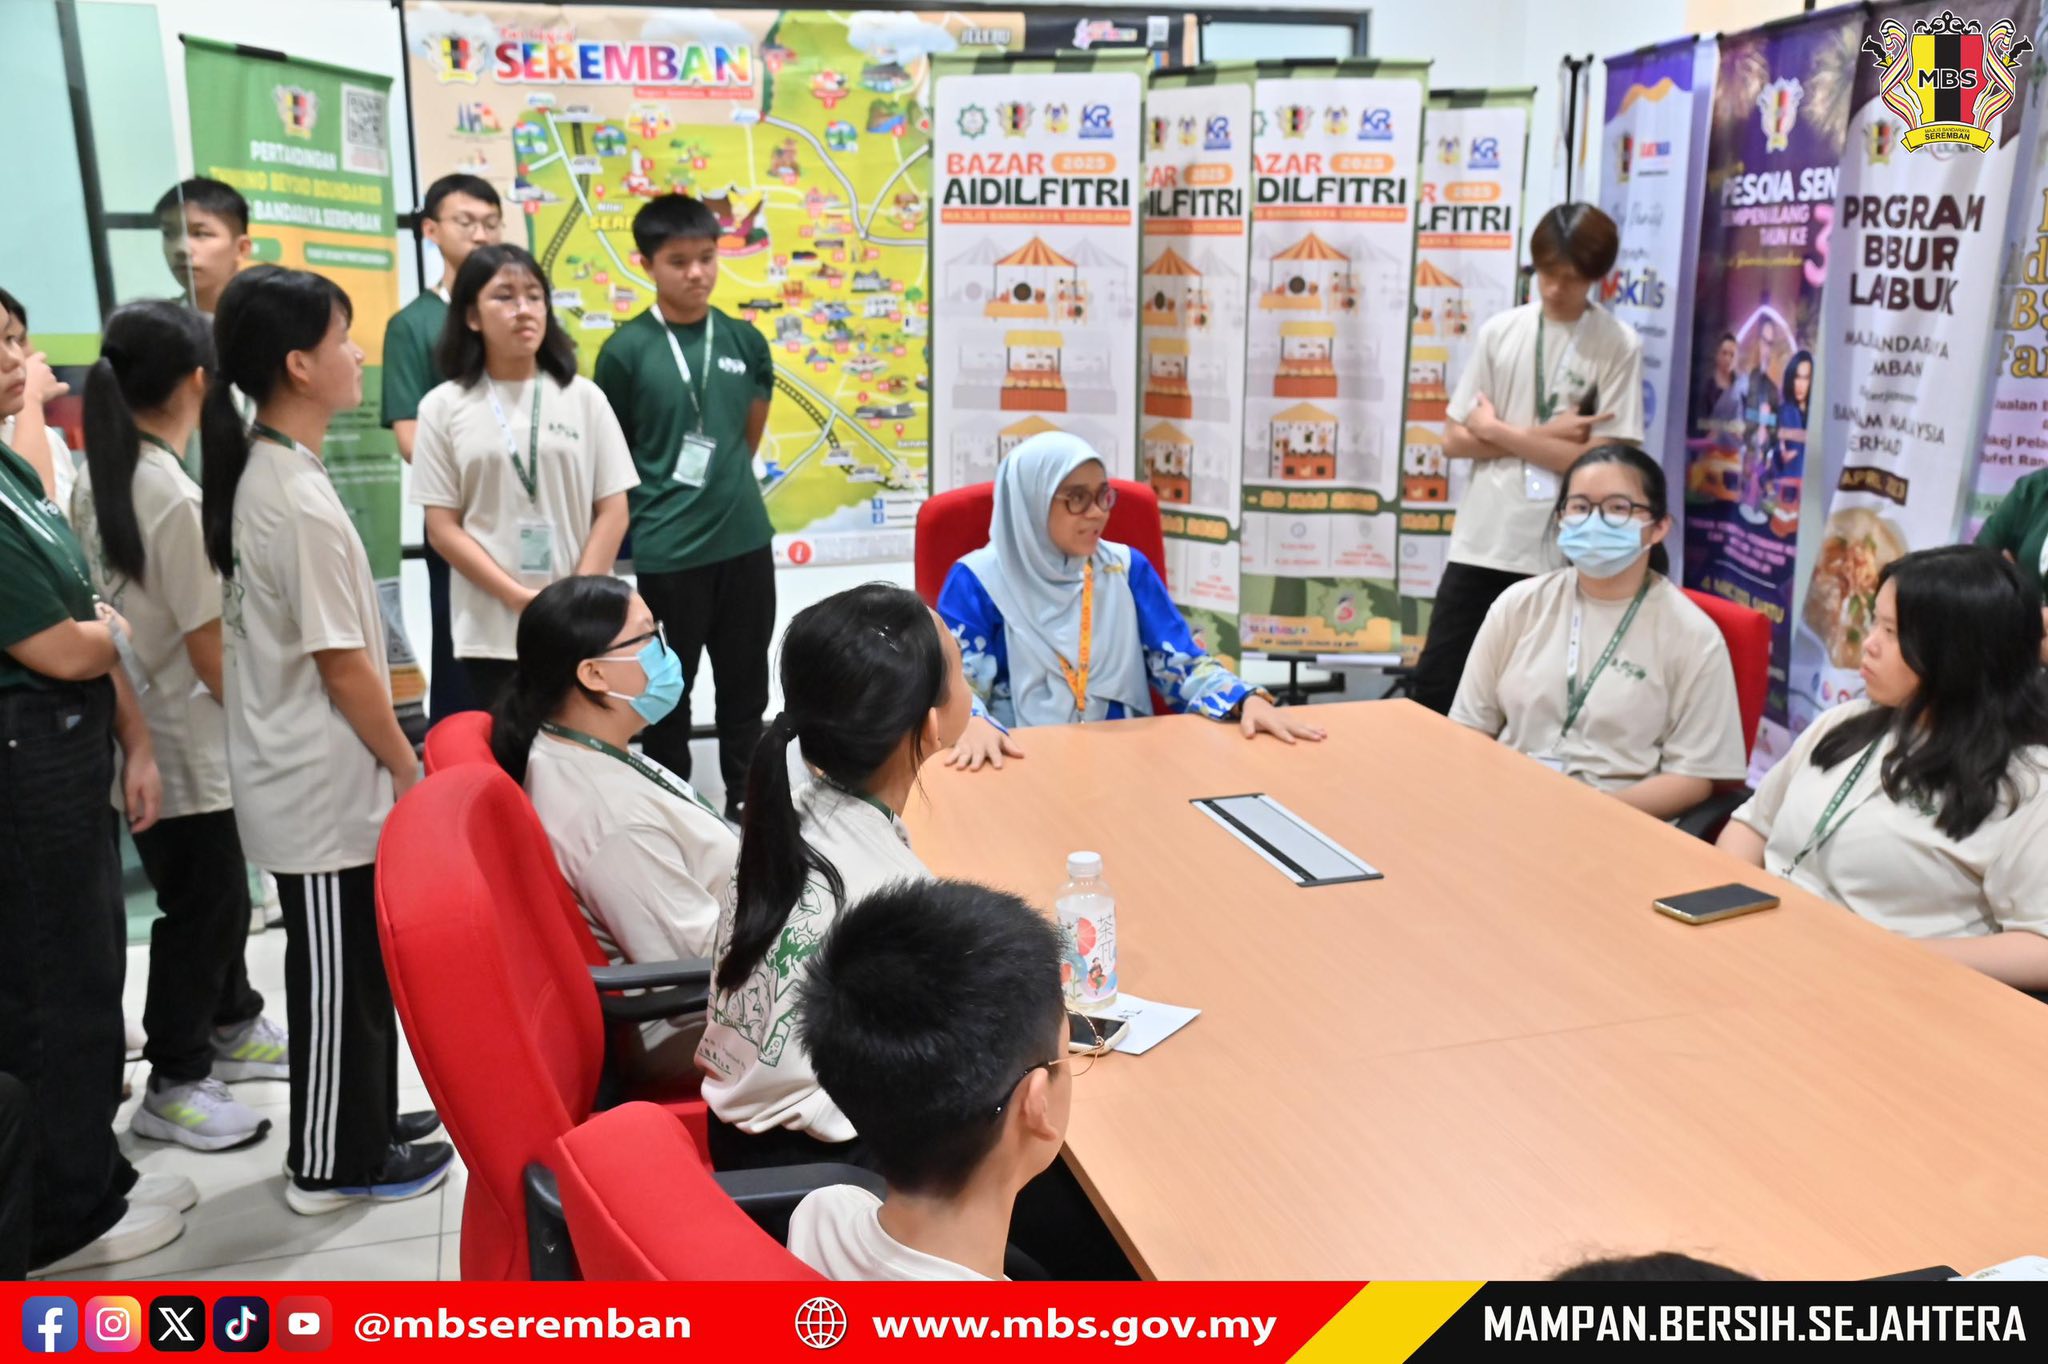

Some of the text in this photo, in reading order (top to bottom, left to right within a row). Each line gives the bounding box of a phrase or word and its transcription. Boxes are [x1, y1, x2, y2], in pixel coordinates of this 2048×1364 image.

[495, 42, 750, 84] SEREMBAN
[947, 153, 1044, 175] BAZAR
[943, 178, 1129, 206] AIDILFITRI
[1147, 189, 1242, 216] ILFITRI
[1850, 273, 1959, 315] LABUK
